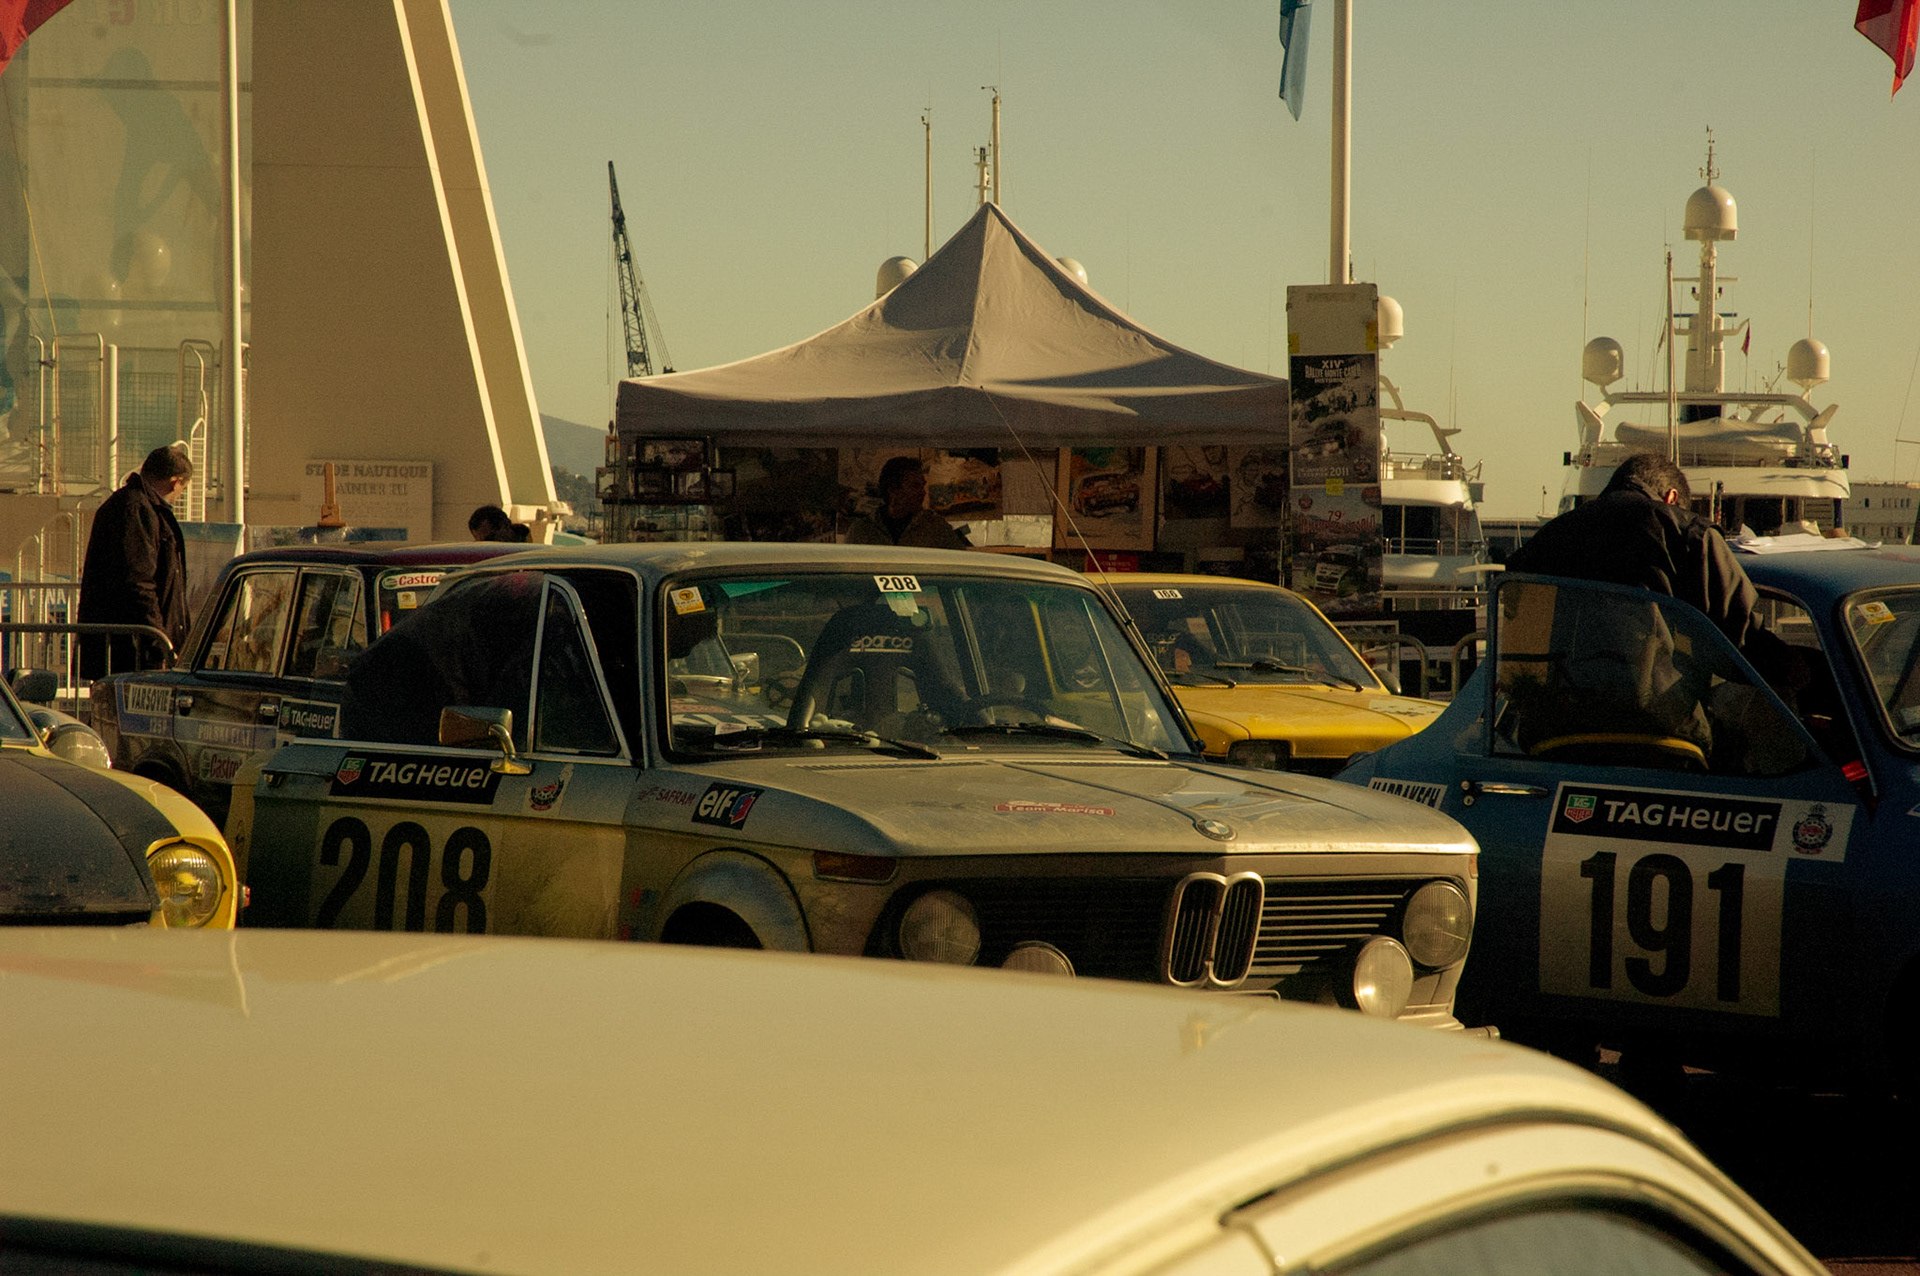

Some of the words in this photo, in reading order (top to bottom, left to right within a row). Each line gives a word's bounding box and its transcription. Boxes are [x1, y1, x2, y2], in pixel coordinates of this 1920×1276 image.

[305, 463, 351, 477] STDE
[354, 465, 428, 479] NAUTIQUE
[1329, 466, 1349, 477] 2011
[335, 482, 386, 496] AINIER
[398, 574, 442, 586] Castro
[878, 576, 917, 591] 208
[850, 634, 914, 651] sparco
[131, 684, 170, 713] VARSOVIE
[209, 753, 242, 779] Castro
[656, 788, 697, 806] SAFRAM
[698, 788, 740, 819] elf
[1007, 804, 1047, 812] Team
[1052, 806, 1106, 816] Marisa
[315, 816, 492, 934] 208
[1579, 850, 1745, 1004] 191
